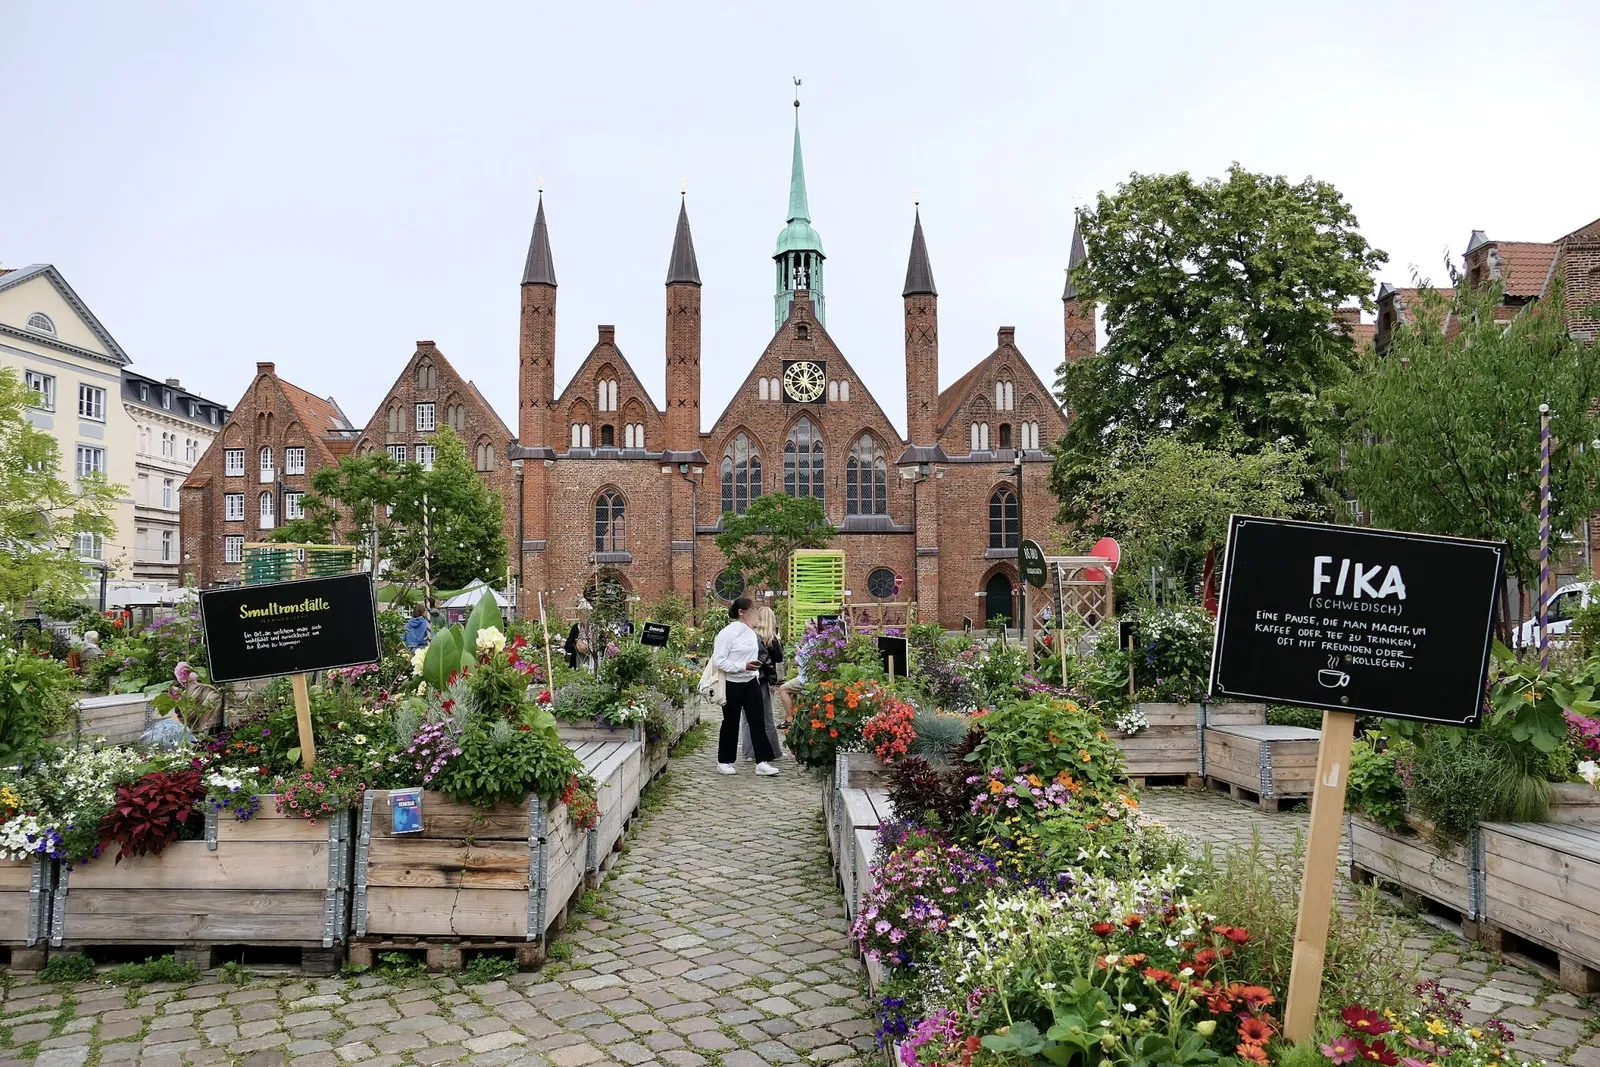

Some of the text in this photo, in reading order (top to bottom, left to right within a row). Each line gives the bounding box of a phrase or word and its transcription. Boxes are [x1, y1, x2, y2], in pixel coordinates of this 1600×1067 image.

[1313, 556, 1406, 600] FIKA
[240, 598, 330, 618] Smultronställe
[1309, 597, 1402, 616] (SCHWEDISCH)
[1285, 614, 1319, 626] PAUSE,
[1323, 618, 1338, 626] DIE
[1343, 620, 1367, 629] MAN
[1372, 623, 1409, 635] MACHT,
[1413, 627, 1426, 635] UM
[1255, 624, 1416, 648] KAFFEE ODER TEE ZU TRINKEN,
[1277, 637, 1414, 658] OFT MIT FREUNDEN ODER
